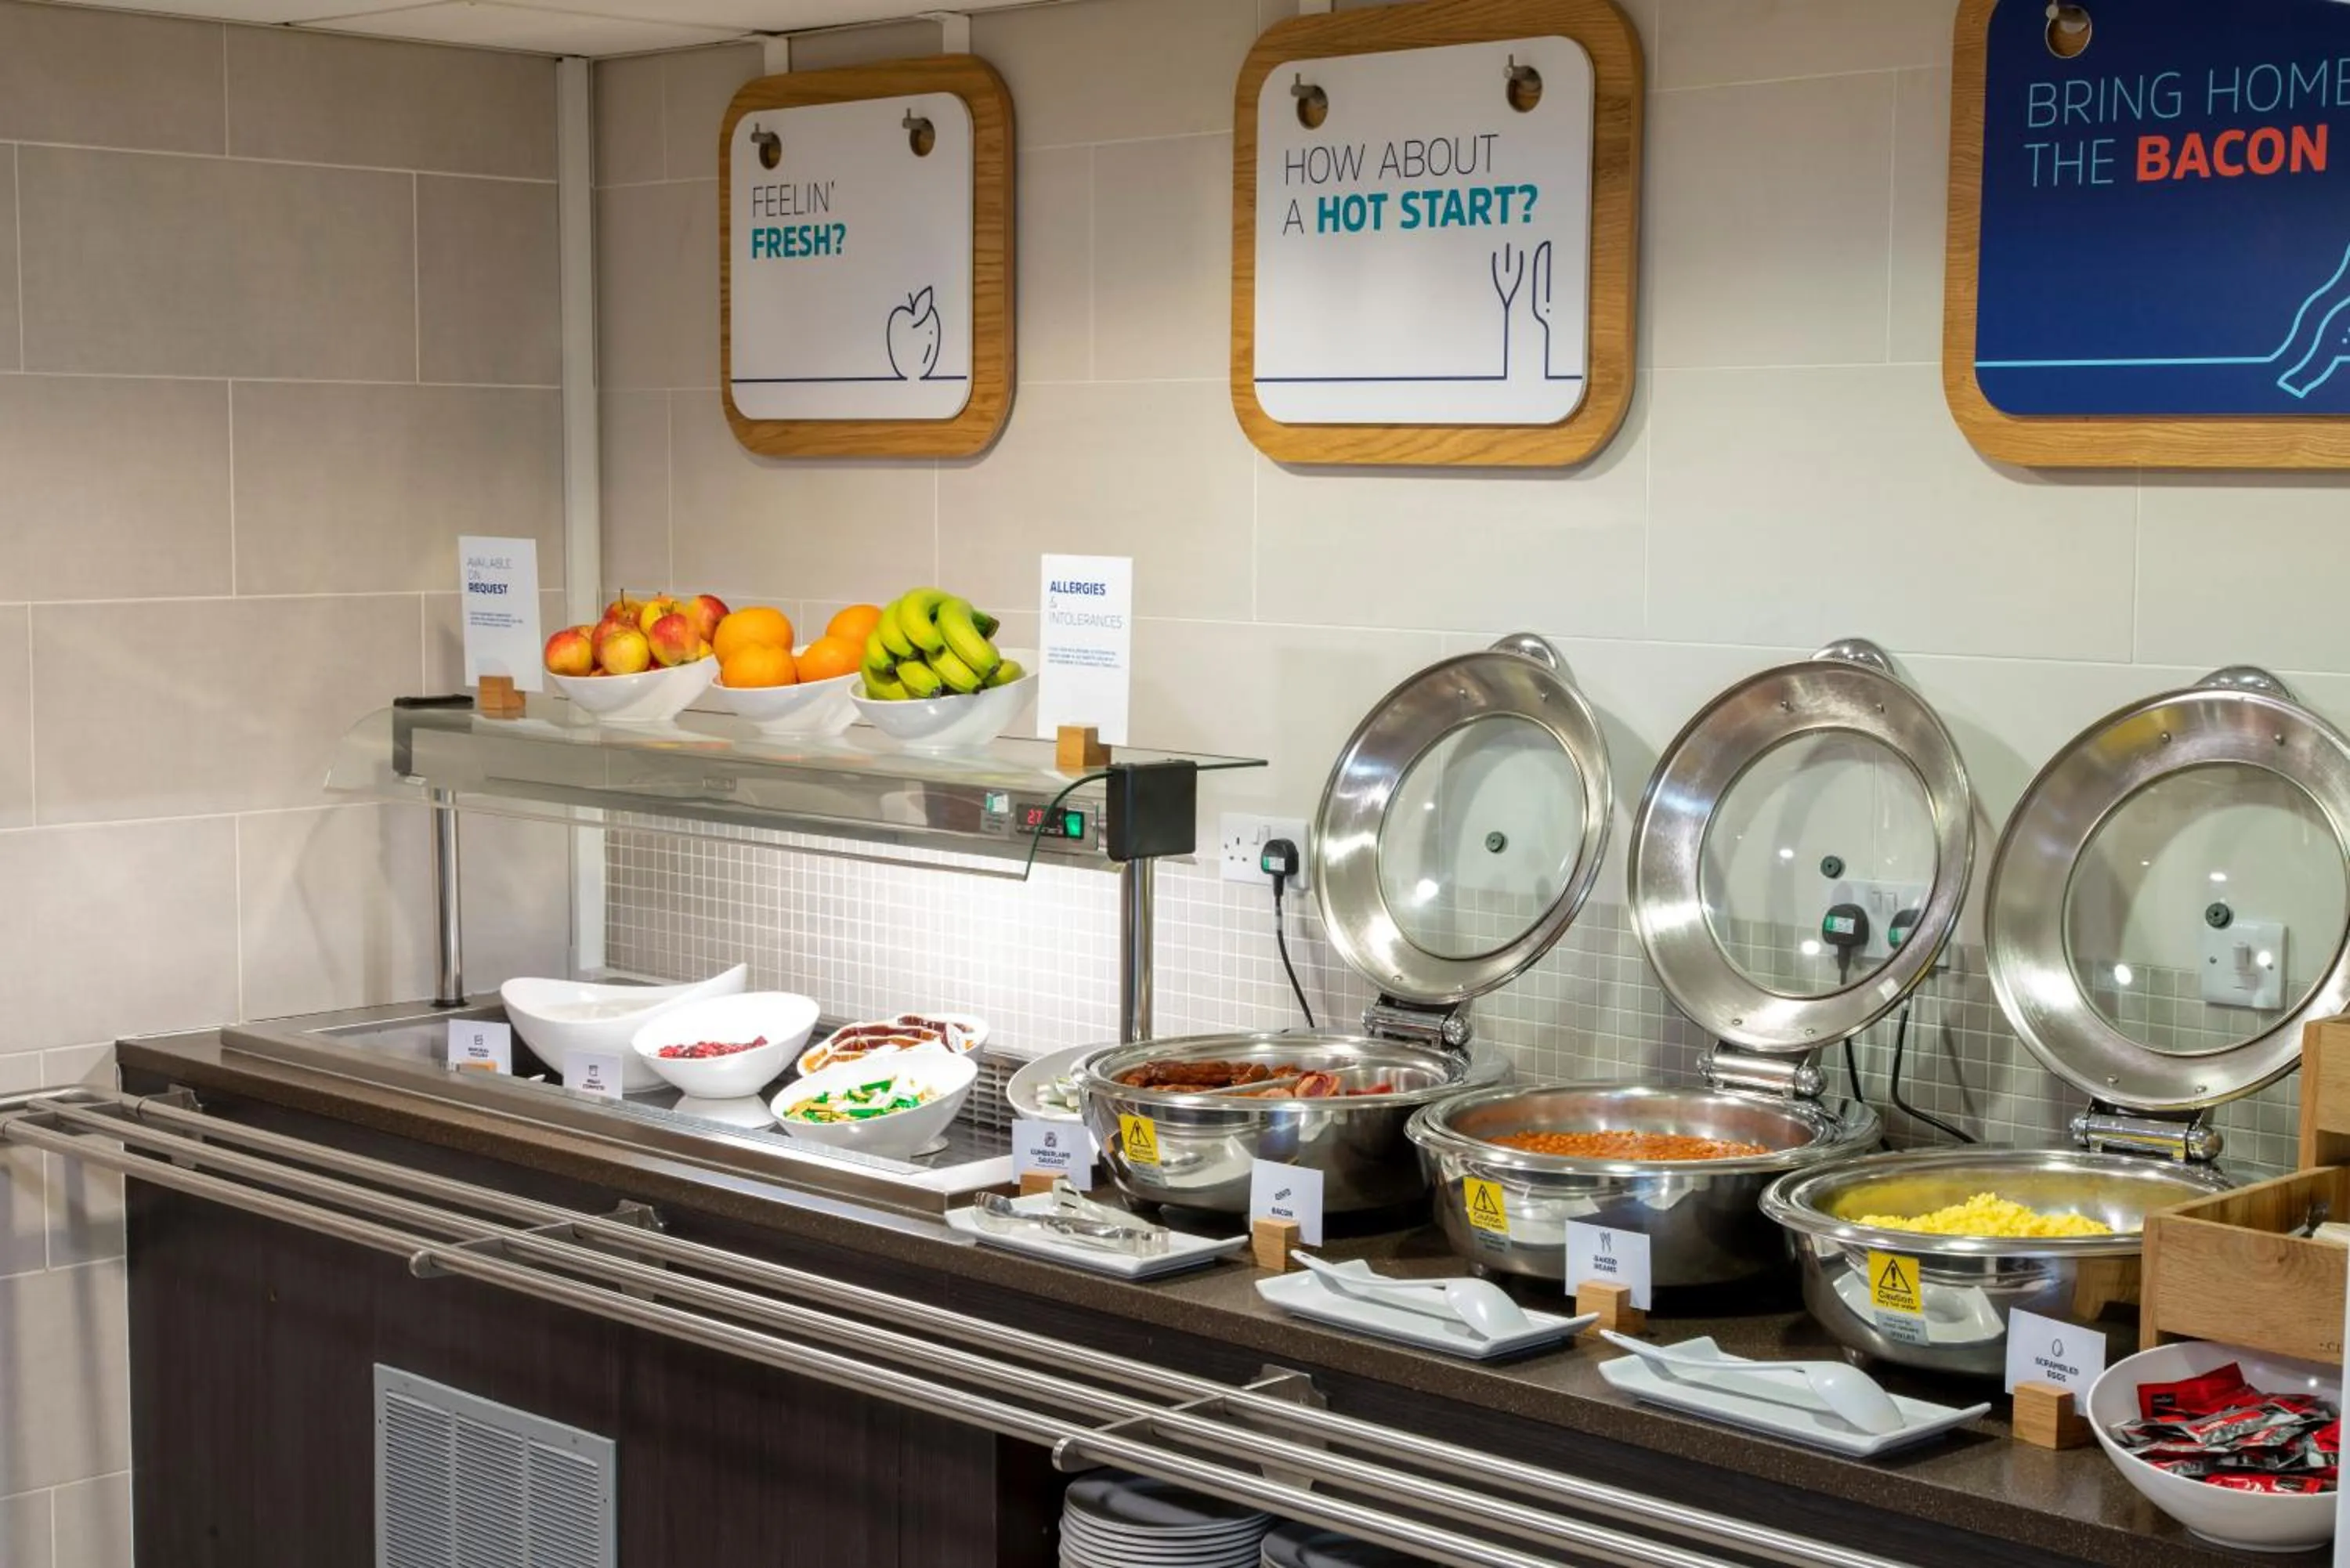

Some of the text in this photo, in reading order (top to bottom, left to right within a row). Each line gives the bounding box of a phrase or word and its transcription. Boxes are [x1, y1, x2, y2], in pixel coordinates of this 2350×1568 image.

[2027, 71, 2182, 128] BRING
[1285, 133, 1499, 186] HOW ABOUT
[2023, 123, 2329, 188] THE BACON
[751, 180, 835, 219] FEELIN'
[1282, 183, 1538, 237] A HOT START?
[750, 222, 847, 259] FRESH?
[468, 582, 508, 595] REQUEST
[1049, 580, 1107, 596] ALLERGIES
[1048, 611, 1123, 630] INTOLERANCES
[1271, 1207, 1294, 1218] BACON
[2035, 1356, 2080, 1377] SCRAMBLED
[2047, 1369, 2066, 1383] EGGS
